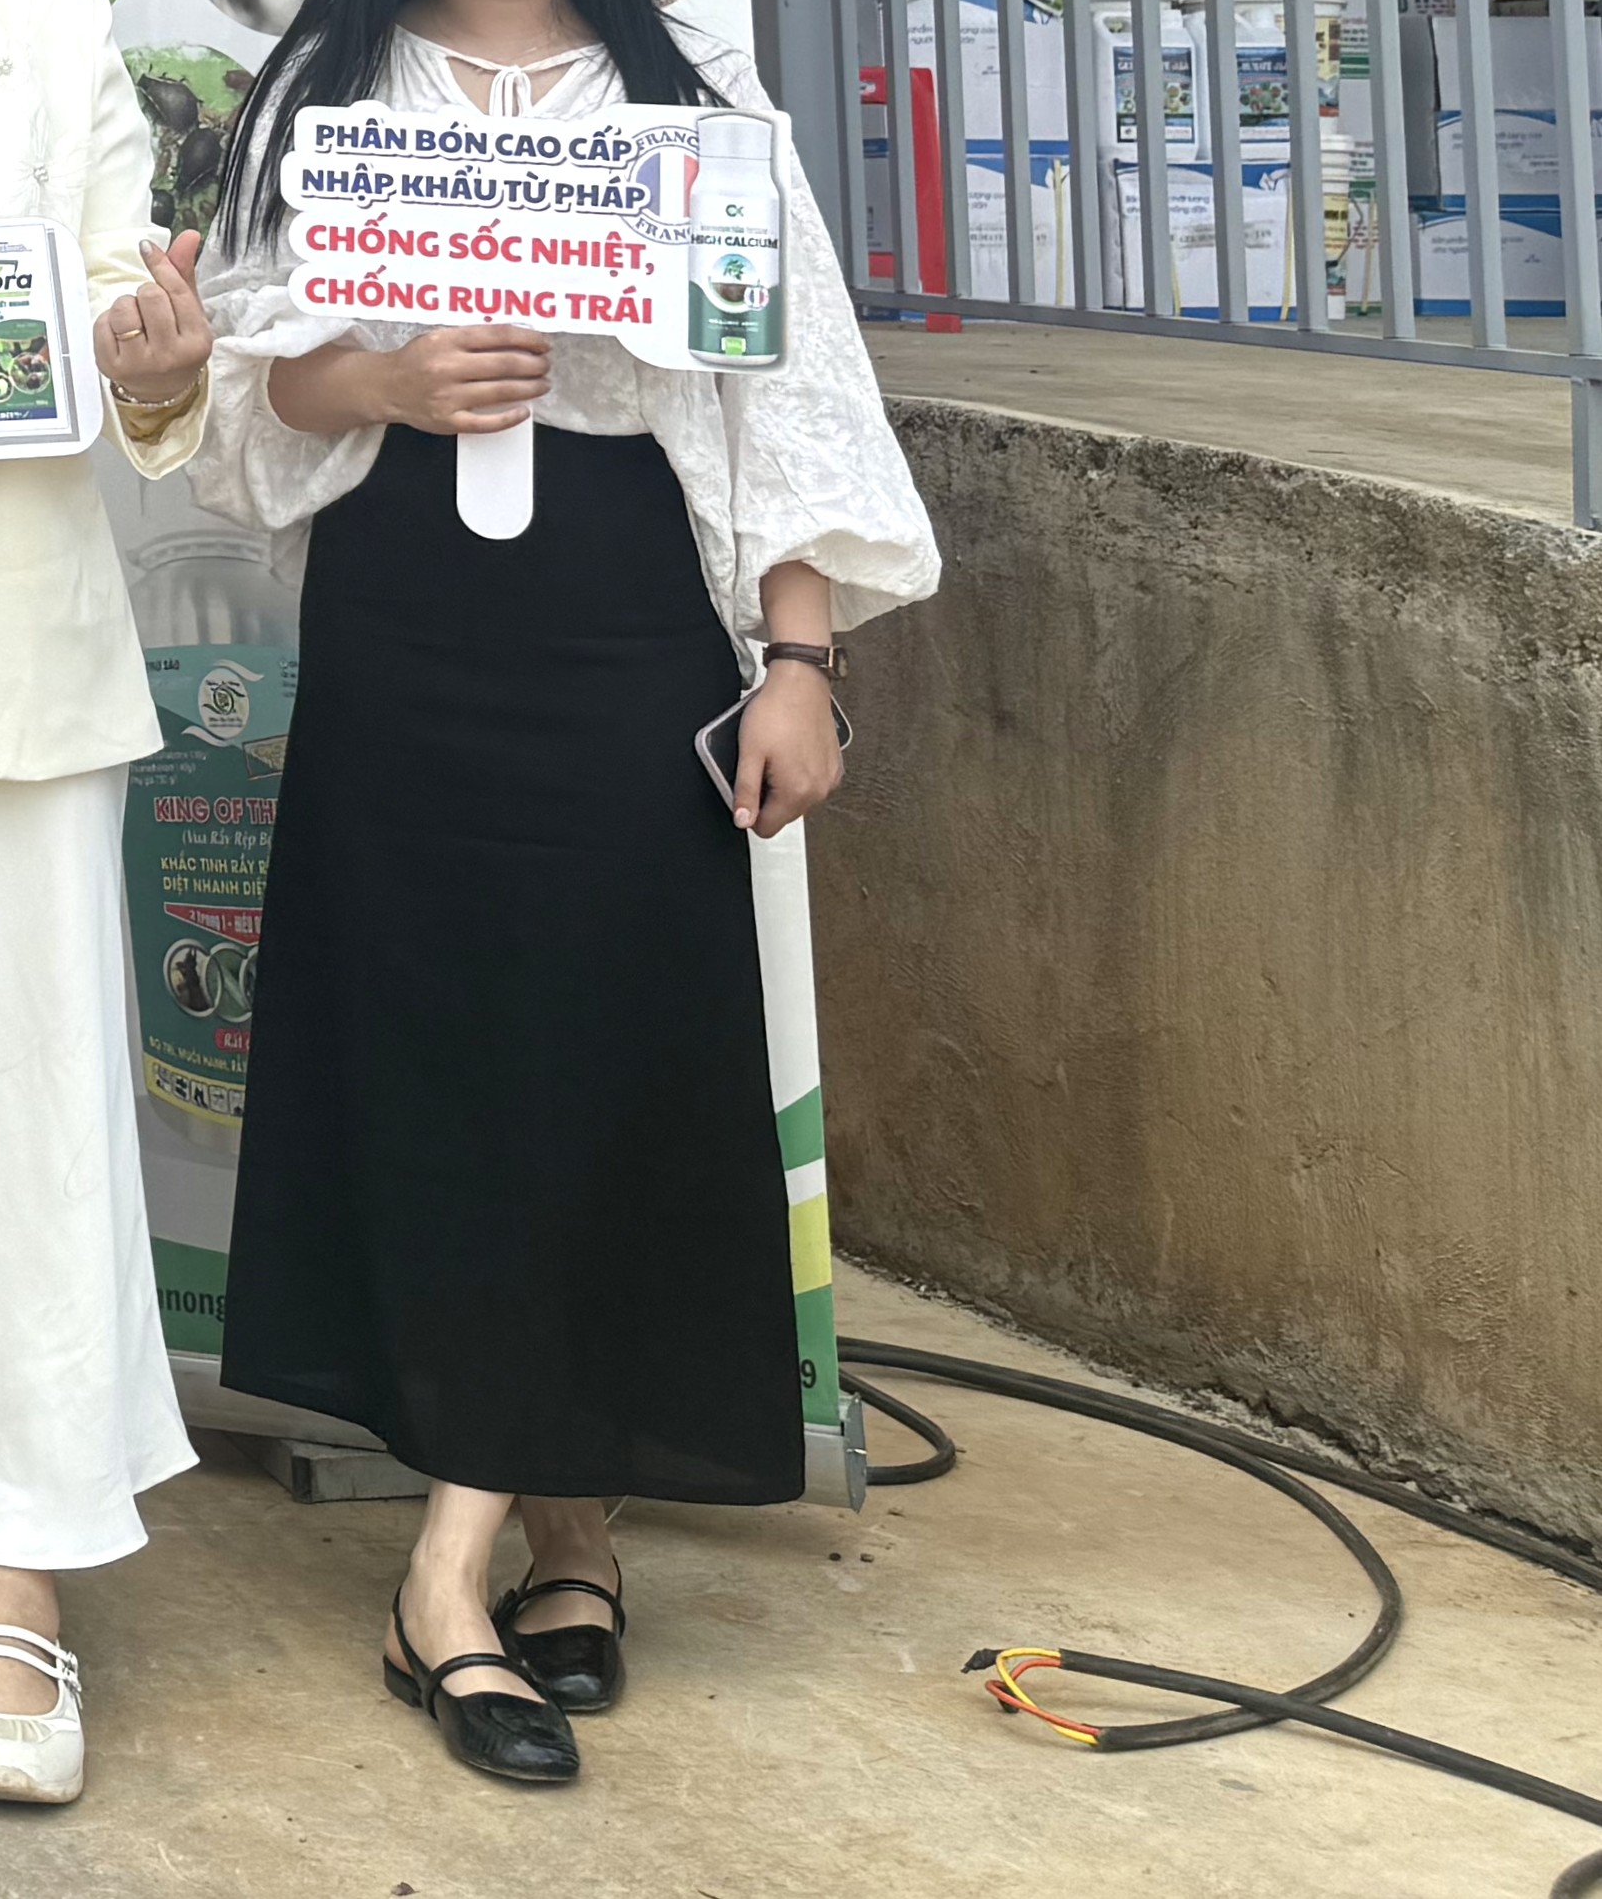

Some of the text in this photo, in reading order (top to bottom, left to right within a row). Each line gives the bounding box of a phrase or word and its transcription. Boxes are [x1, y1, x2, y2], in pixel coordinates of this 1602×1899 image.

[315, 118, 634, 164] PHÂN BÓN CAO CẤP
[301, 164, 646, 212] NHẬP KHẨU TỪ PHÁP
[305, 214, 655, 278] CHỐNG SỐC NHIỆT,
[304, 266, 653, 324] CHỐNG RỤNG TRÁI
[154, 796, 244, 824] KING OF
[800, 1356, 818, 1390] 9
